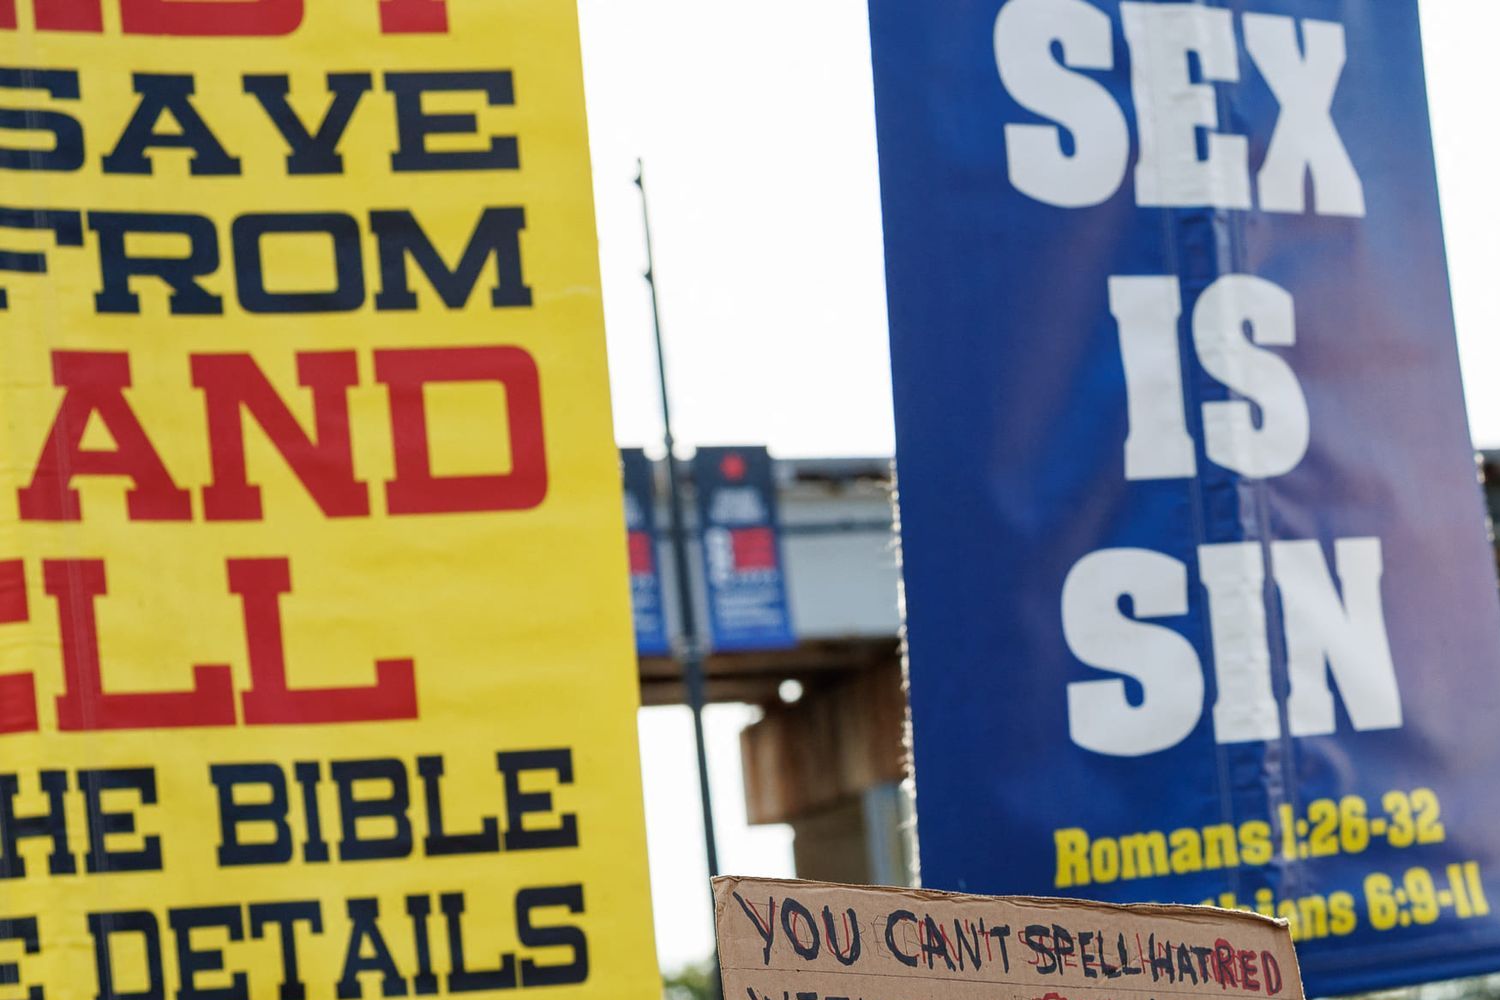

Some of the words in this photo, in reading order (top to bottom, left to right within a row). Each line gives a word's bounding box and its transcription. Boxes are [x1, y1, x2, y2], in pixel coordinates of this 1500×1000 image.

[993, 0, 1366, 217] SEX
[17, 345, 549, 521] AND
[1107, 273, 1310, 480] IS
[0, 556, 418, 735] LL
[1060, 536, 1403, 758] SIN
[209, 747, 579, 867] BIBLE
[1054, 816, 1272, 889] Romans
[1277, 788, 1445, 859] 1:26-32
[732, 891, 861, 966] YOU
[885, 910, 1011, 974] CAN'T
[1022, 922, 1143, 980] SPELL
[1147, 932, 1283, 996] HATRED
[1364, 860, 1490, 931] 6:9-11
